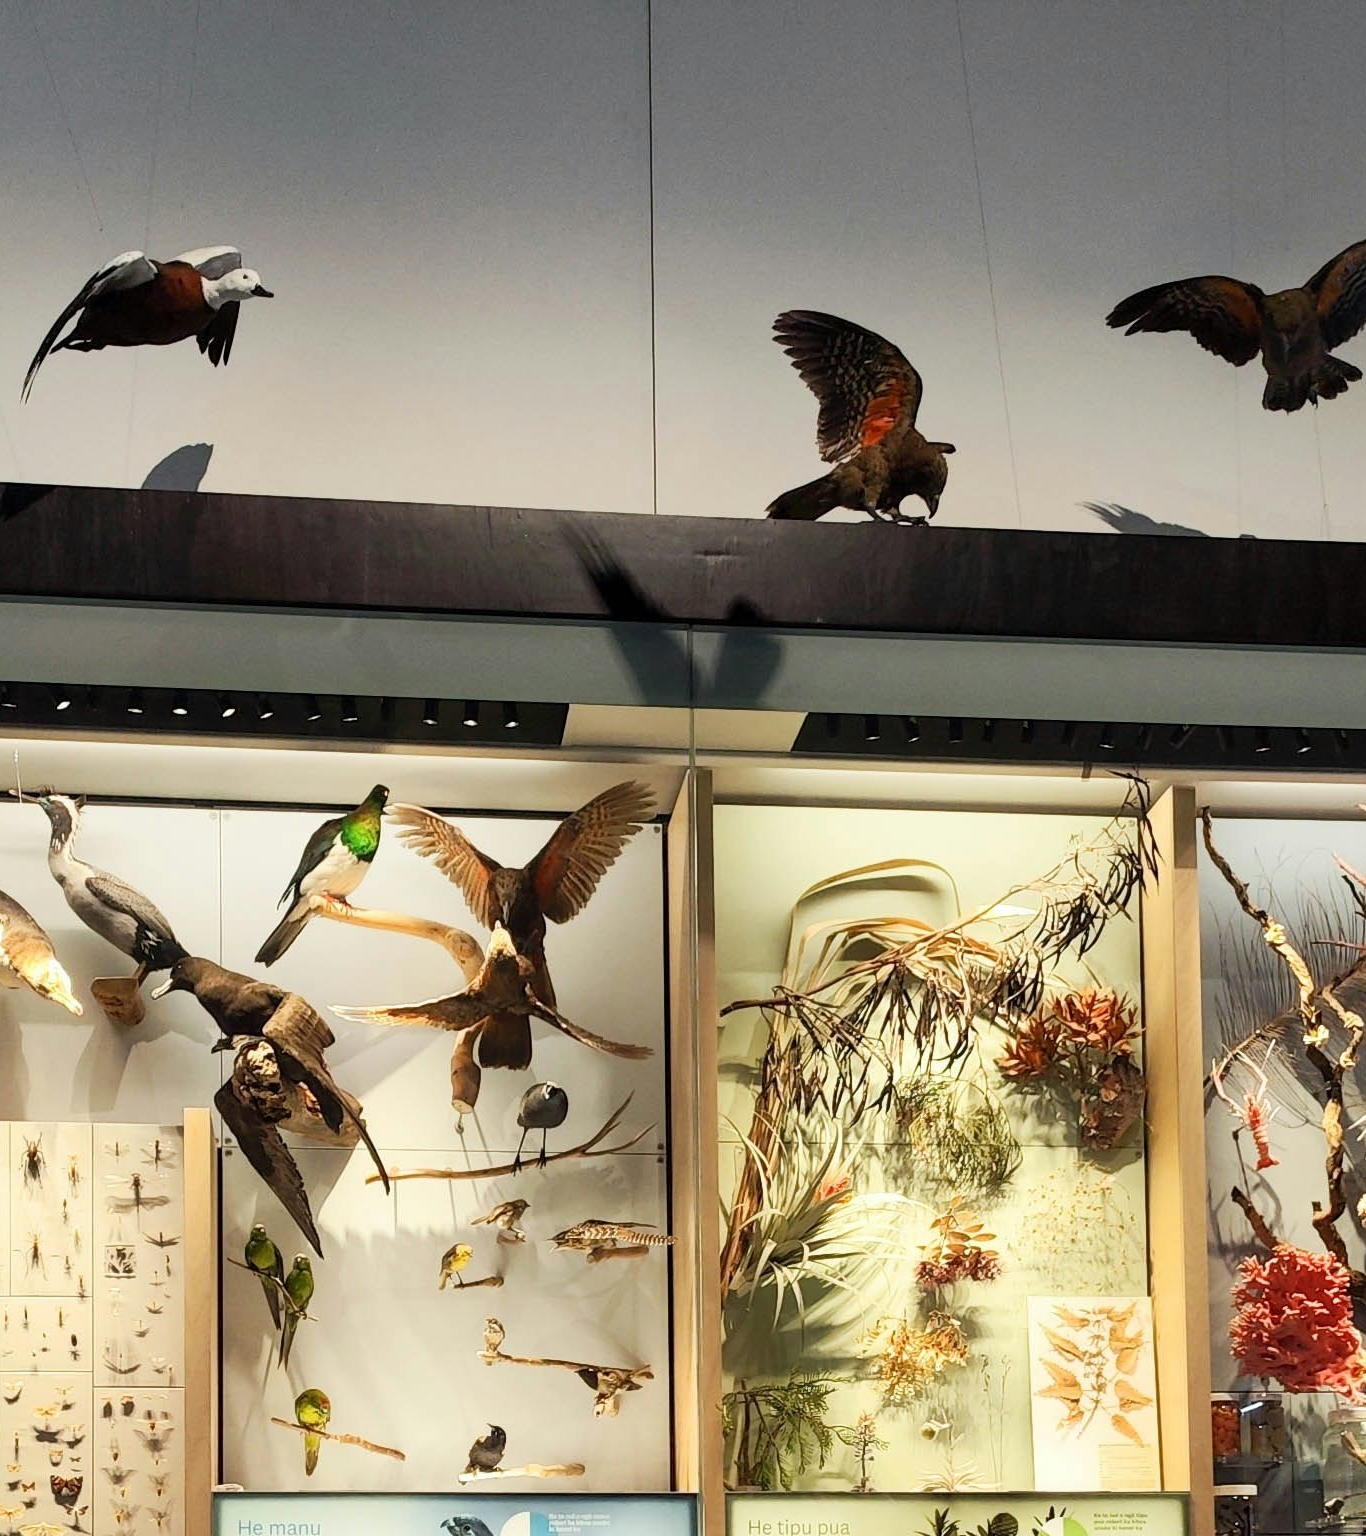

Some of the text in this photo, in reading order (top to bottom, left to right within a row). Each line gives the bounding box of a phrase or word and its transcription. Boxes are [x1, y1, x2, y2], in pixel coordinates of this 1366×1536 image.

[238, 1520, 321, 1536] He manu
[748, 1520, 772, 1535] He
